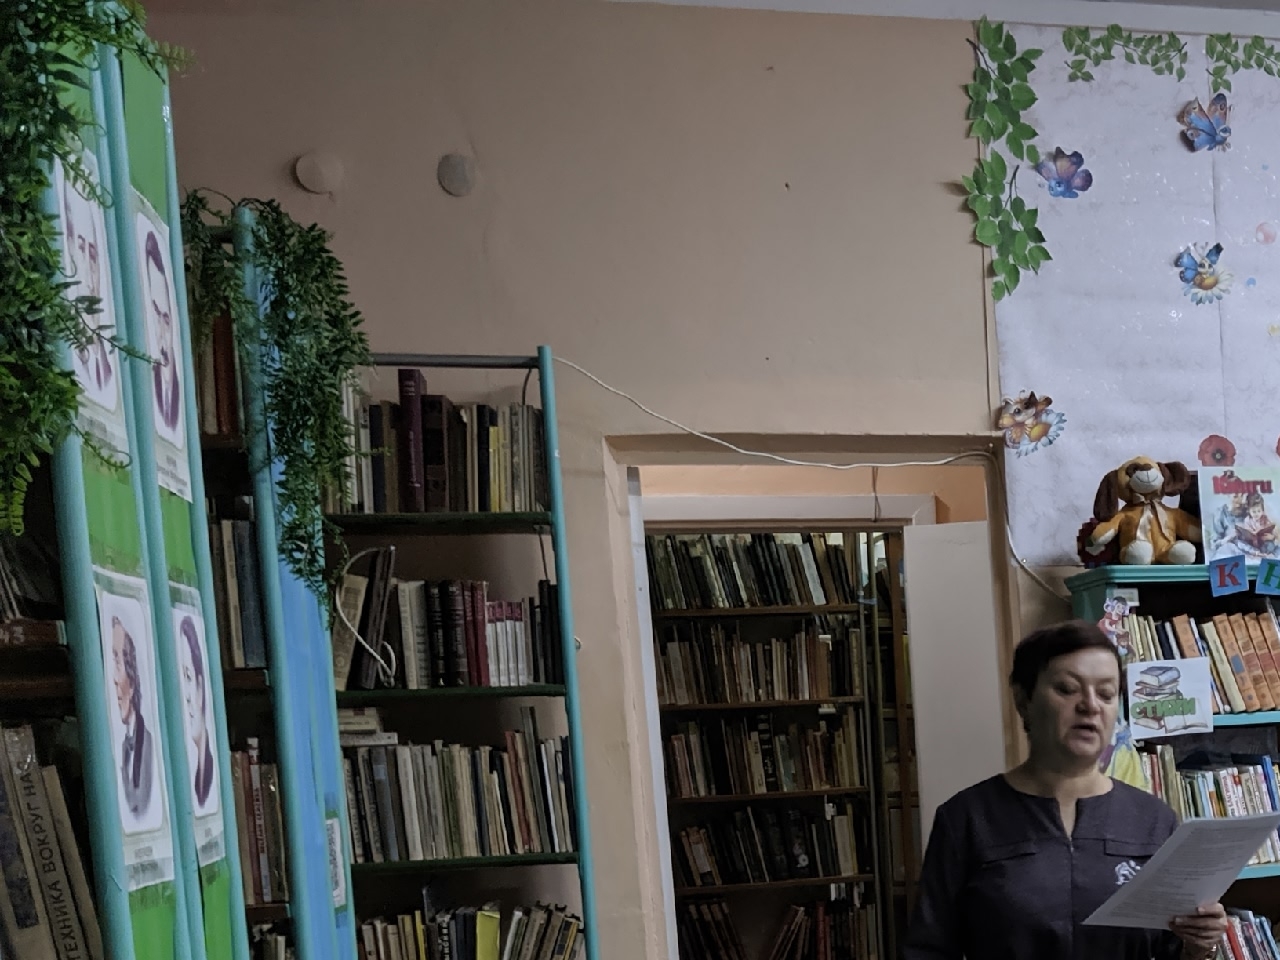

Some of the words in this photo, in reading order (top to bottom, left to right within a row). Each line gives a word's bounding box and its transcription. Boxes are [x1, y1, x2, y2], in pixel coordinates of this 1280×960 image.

[1212, 475, 1273, 495] Книги
[1130, 697, 1196, 719] СТИХИ
[30, 800, 58, 875] ВОКРУГ
